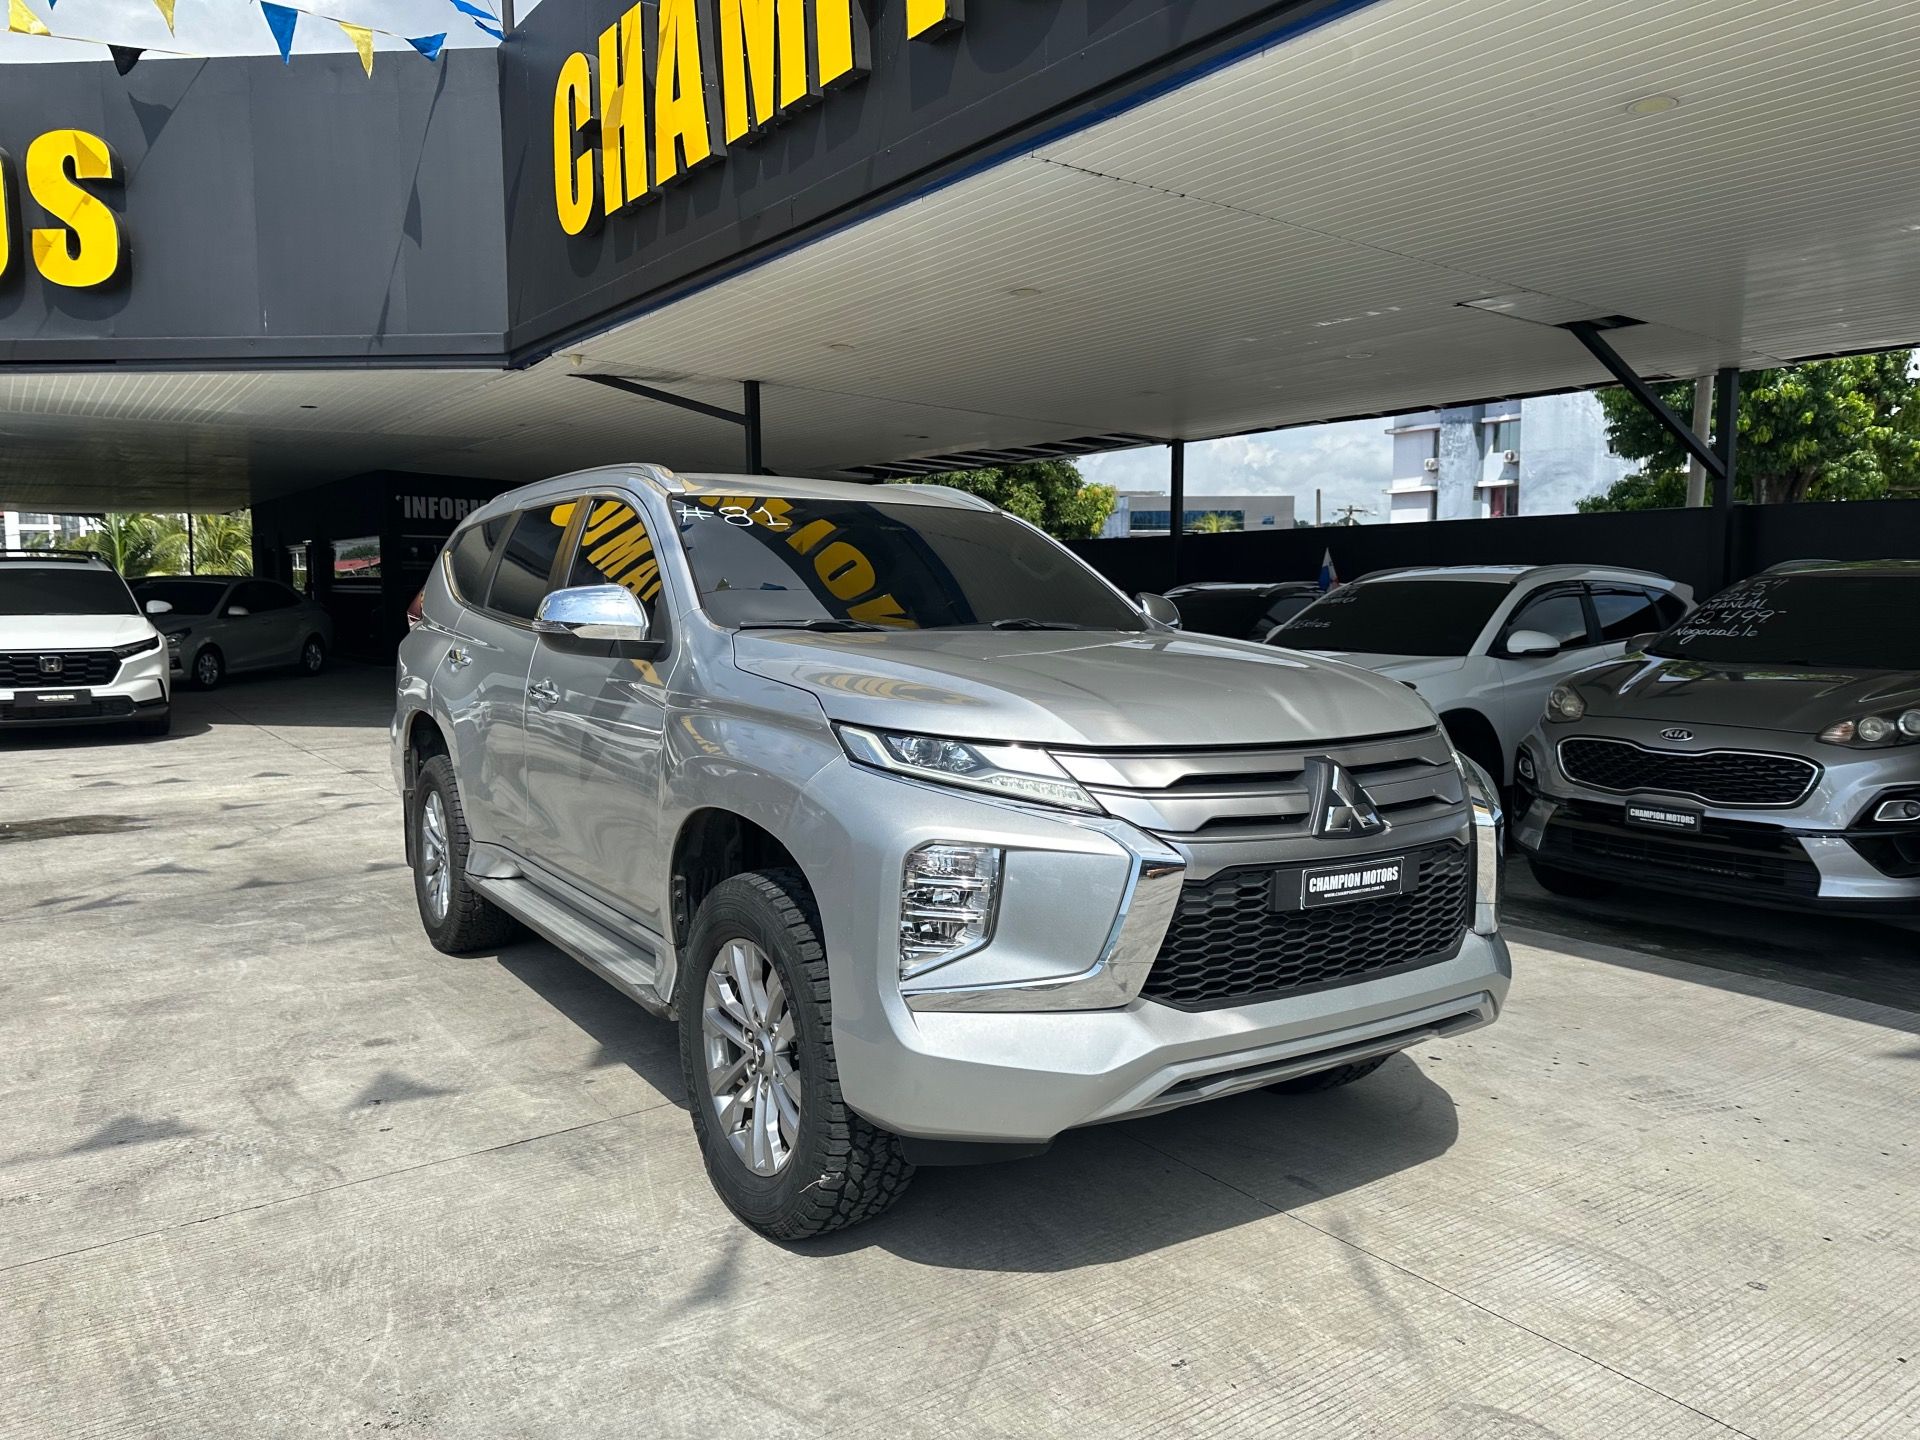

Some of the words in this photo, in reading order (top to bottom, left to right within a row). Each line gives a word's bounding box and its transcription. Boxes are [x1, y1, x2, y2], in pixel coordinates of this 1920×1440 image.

[0, 128, 119, 288] S
[676, 505, 789, 527] #81
[1630, 808, 1665, 820] CHAMPION
[1666, 814, 1695, 825] MOTORS
[1309, 872, 1360, 892] CHAMPION
[1362, 866, 1399, 885] MOTORS
